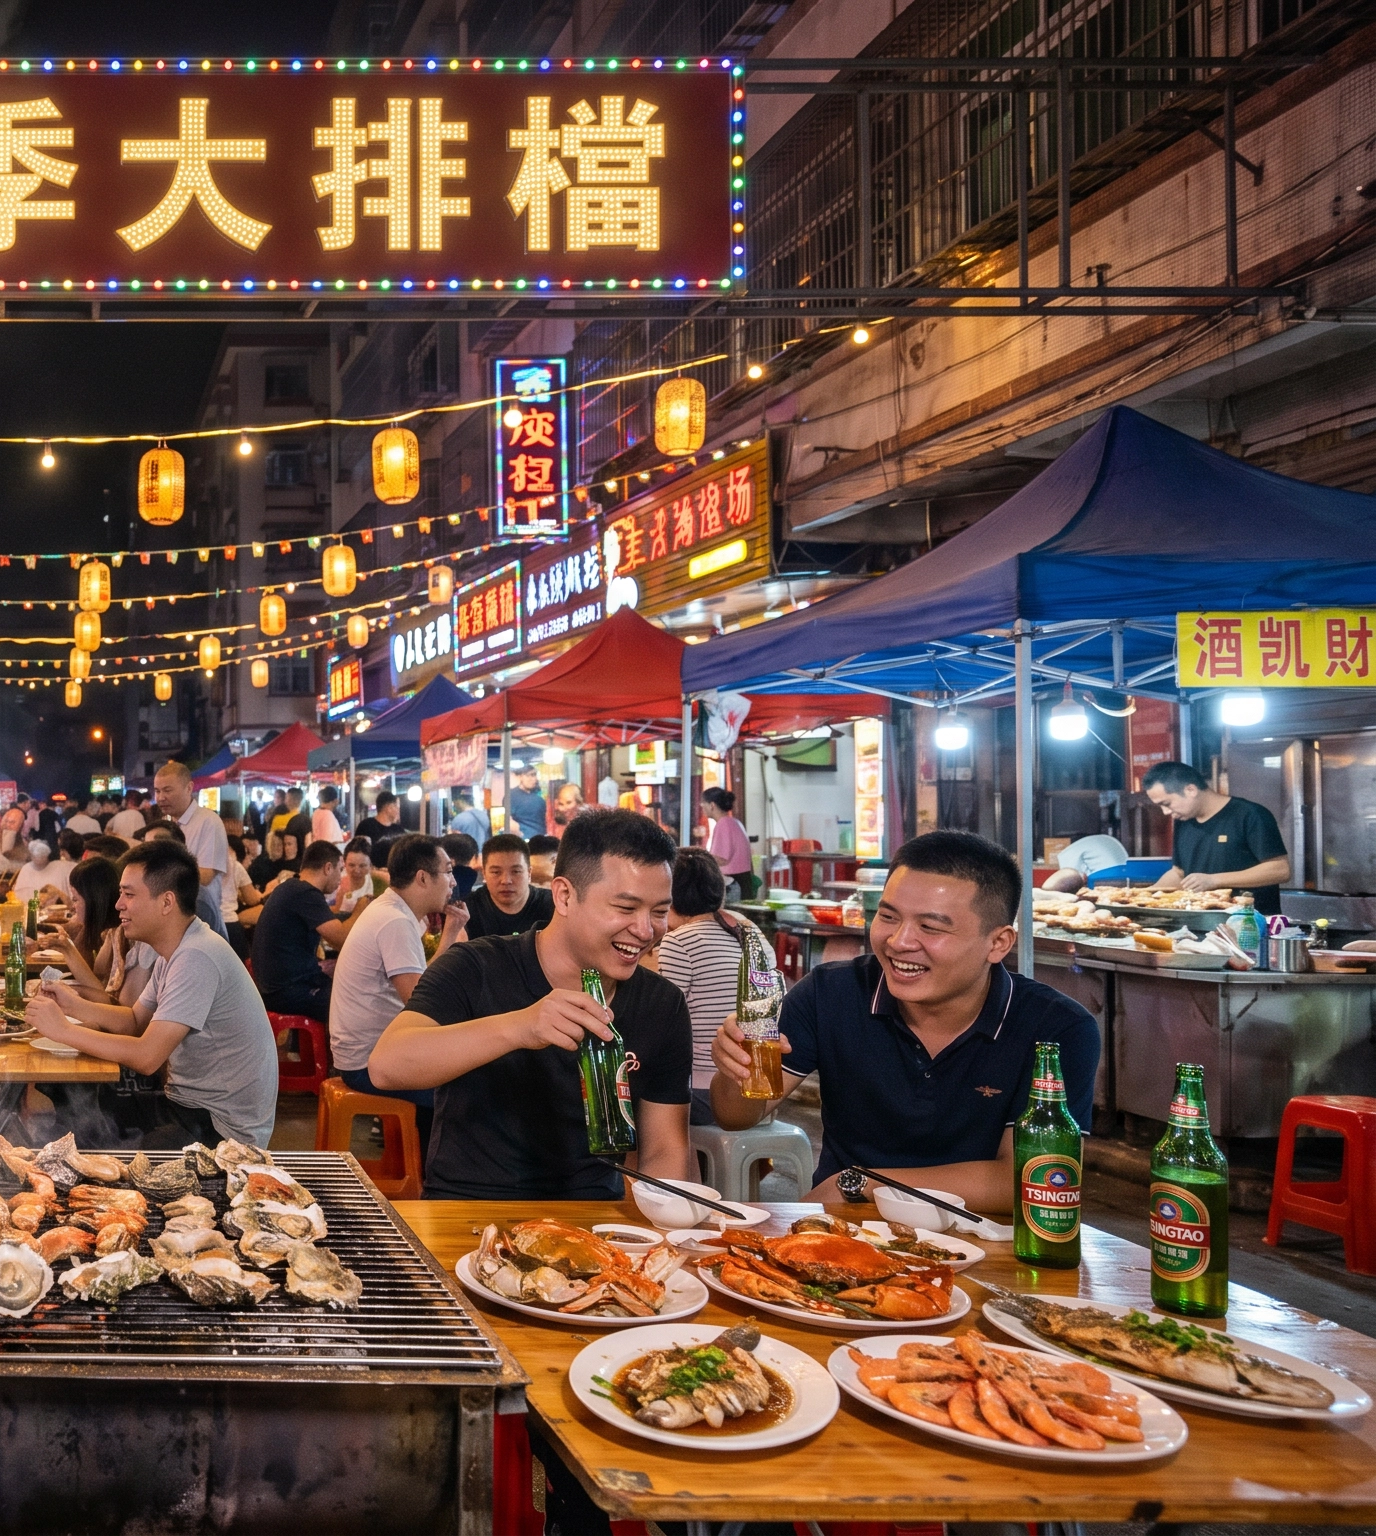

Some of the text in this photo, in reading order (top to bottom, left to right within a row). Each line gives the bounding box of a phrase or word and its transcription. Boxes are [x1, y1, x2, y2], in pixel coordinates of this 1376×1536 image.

[1194, 616, 1373, 678] 酒凯財
[1150, 1218, 1205, 1243] SINGTAO
